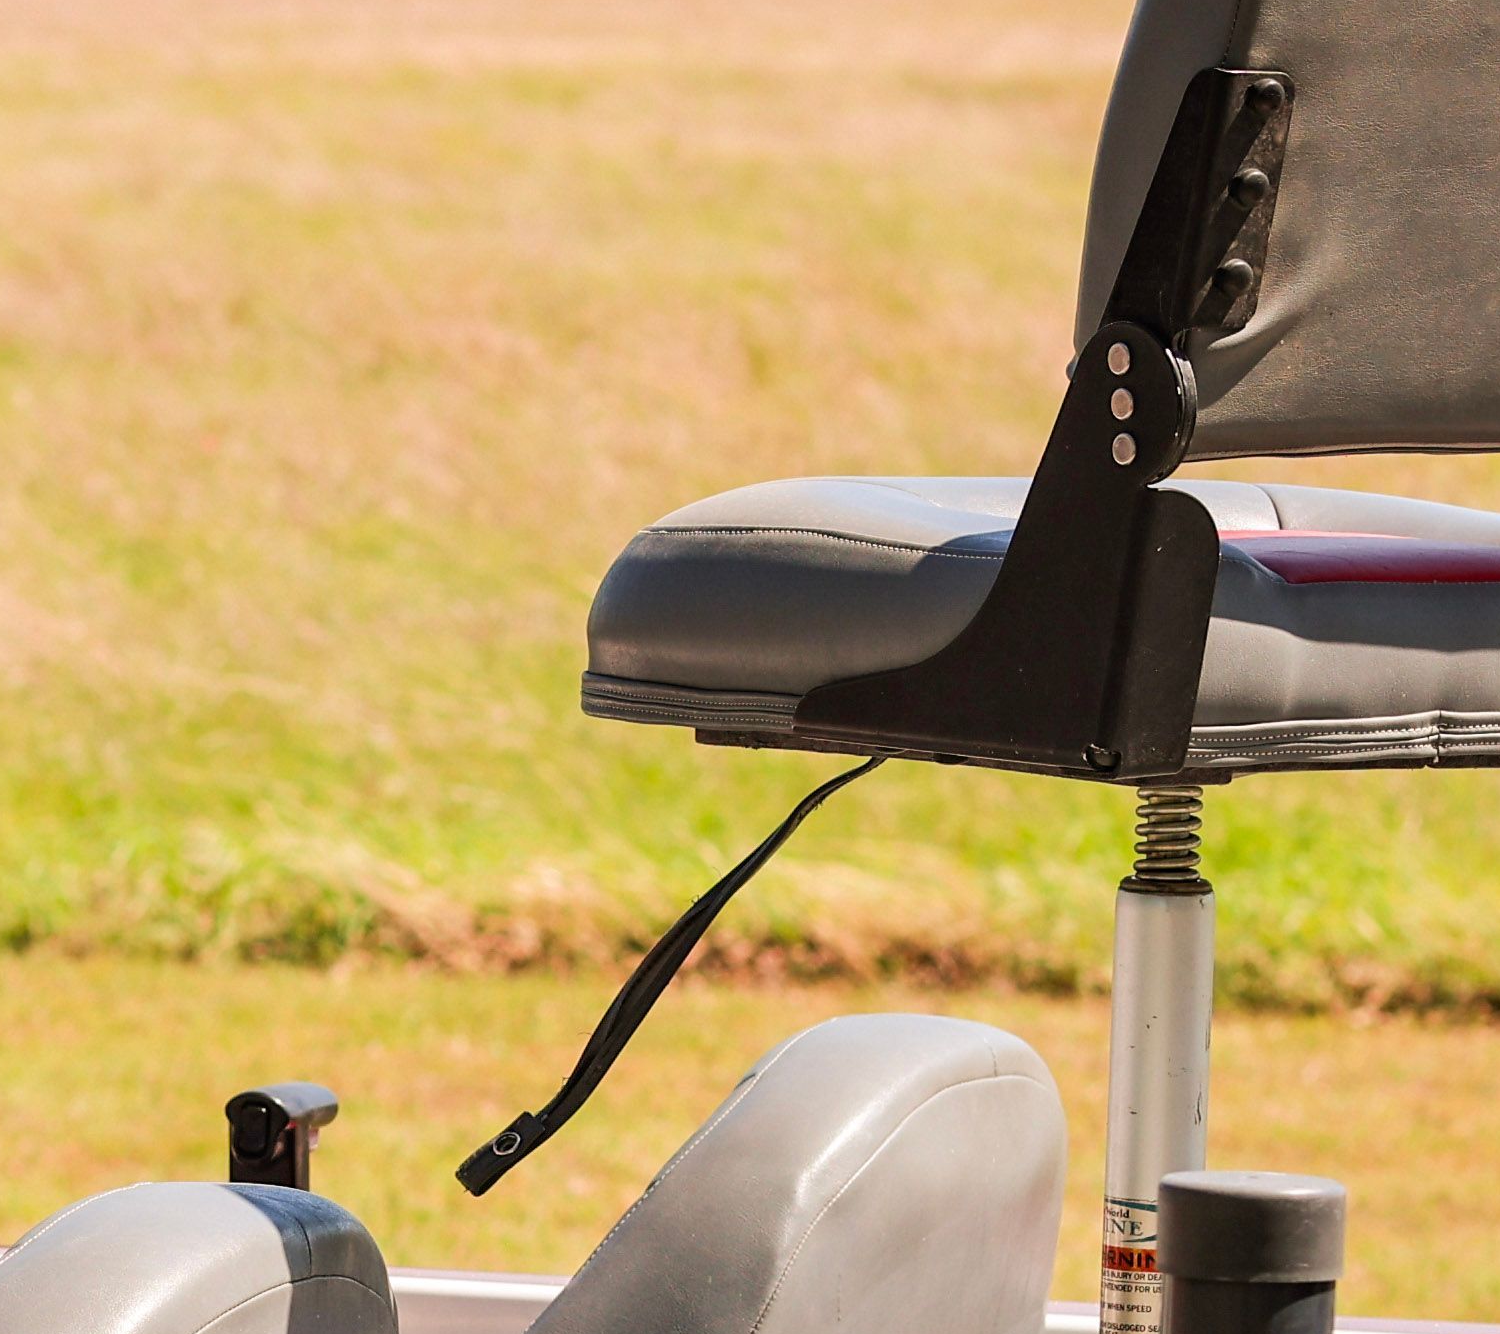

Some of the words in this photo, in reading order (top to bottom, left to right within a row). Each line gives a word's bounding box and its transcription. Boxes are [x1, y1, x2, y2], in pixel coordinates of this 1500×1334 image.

[1103, 1249, 1158, 1268] RNIN
[1111, 1271, 1132, 1280] INJURY
[1134, 1272, 1146, 1281] OR
[1134, 1285, 1150, 1293] FOR
[1107, 1302, 1125, 1312] WHEN
[1127, 1304, 1152, 1313] SPEED
[1107, 1322, 1146, 1332] DISLODGED
